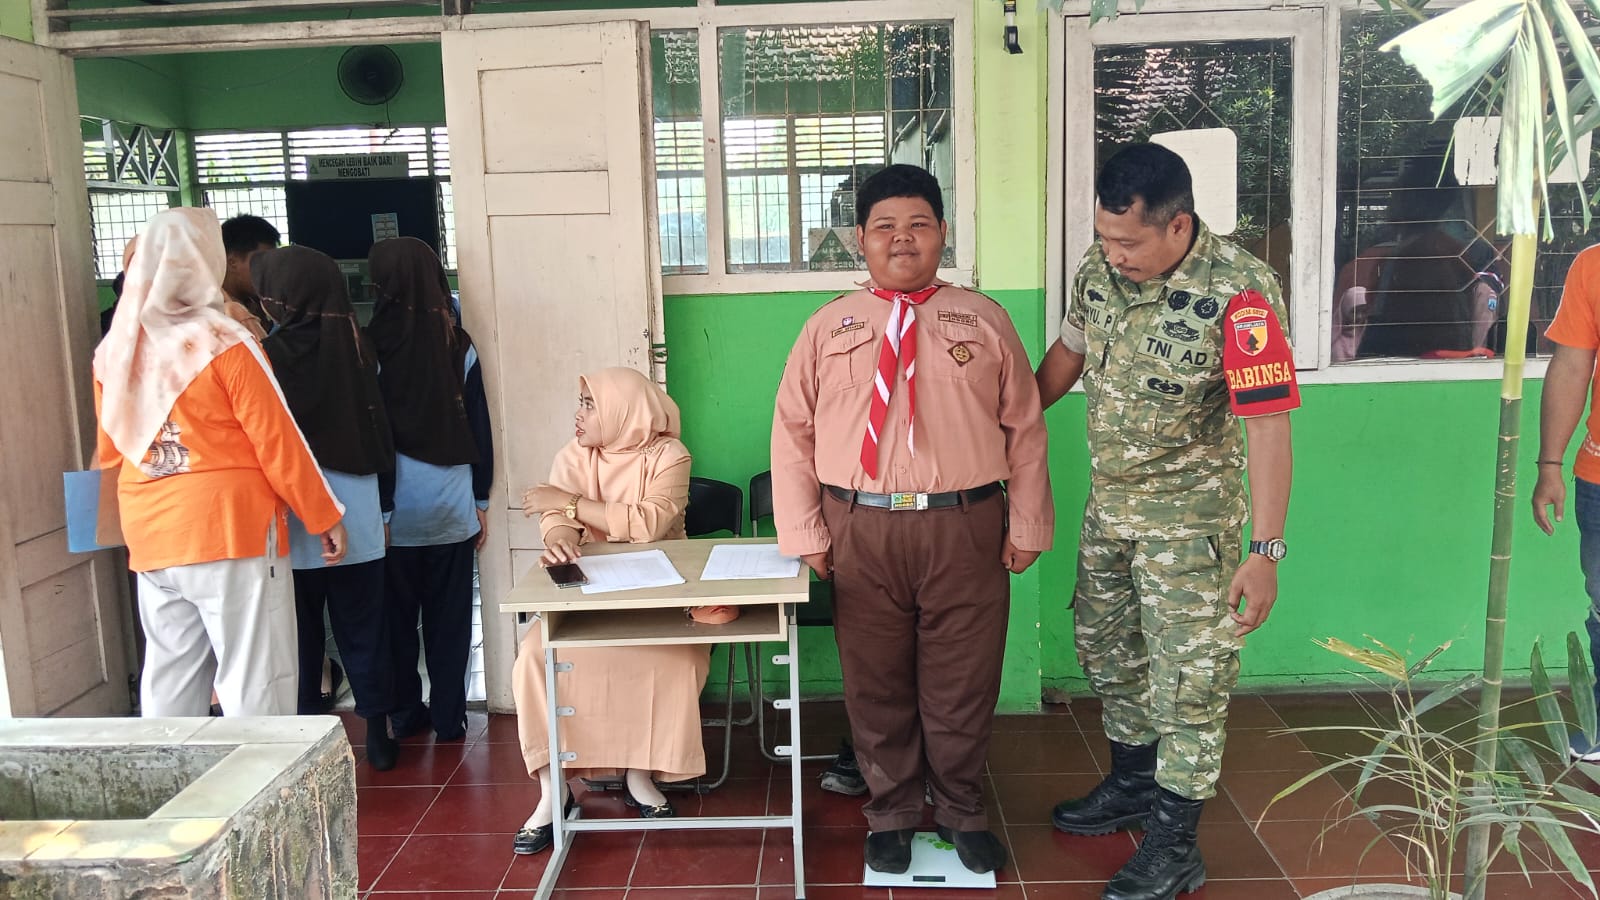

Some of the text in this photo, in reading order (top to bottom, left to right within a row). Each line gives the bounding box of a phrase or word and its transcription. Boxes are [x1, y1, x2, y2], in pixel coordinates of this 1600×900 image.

[319, 159, 345, 168] MENCEGAH
[346, 158, 362, 167] LEBIH
[363, 157, 378, 166] BAIK
[379, 156, 393, 165] DARI
[338, 168, 370, 177] MENGOBATI
[1104, 314, 1112, 329] P
[1146, 337, 1208, 366] TNI AD
[1226, 361, 1292, 390] BABINSA
